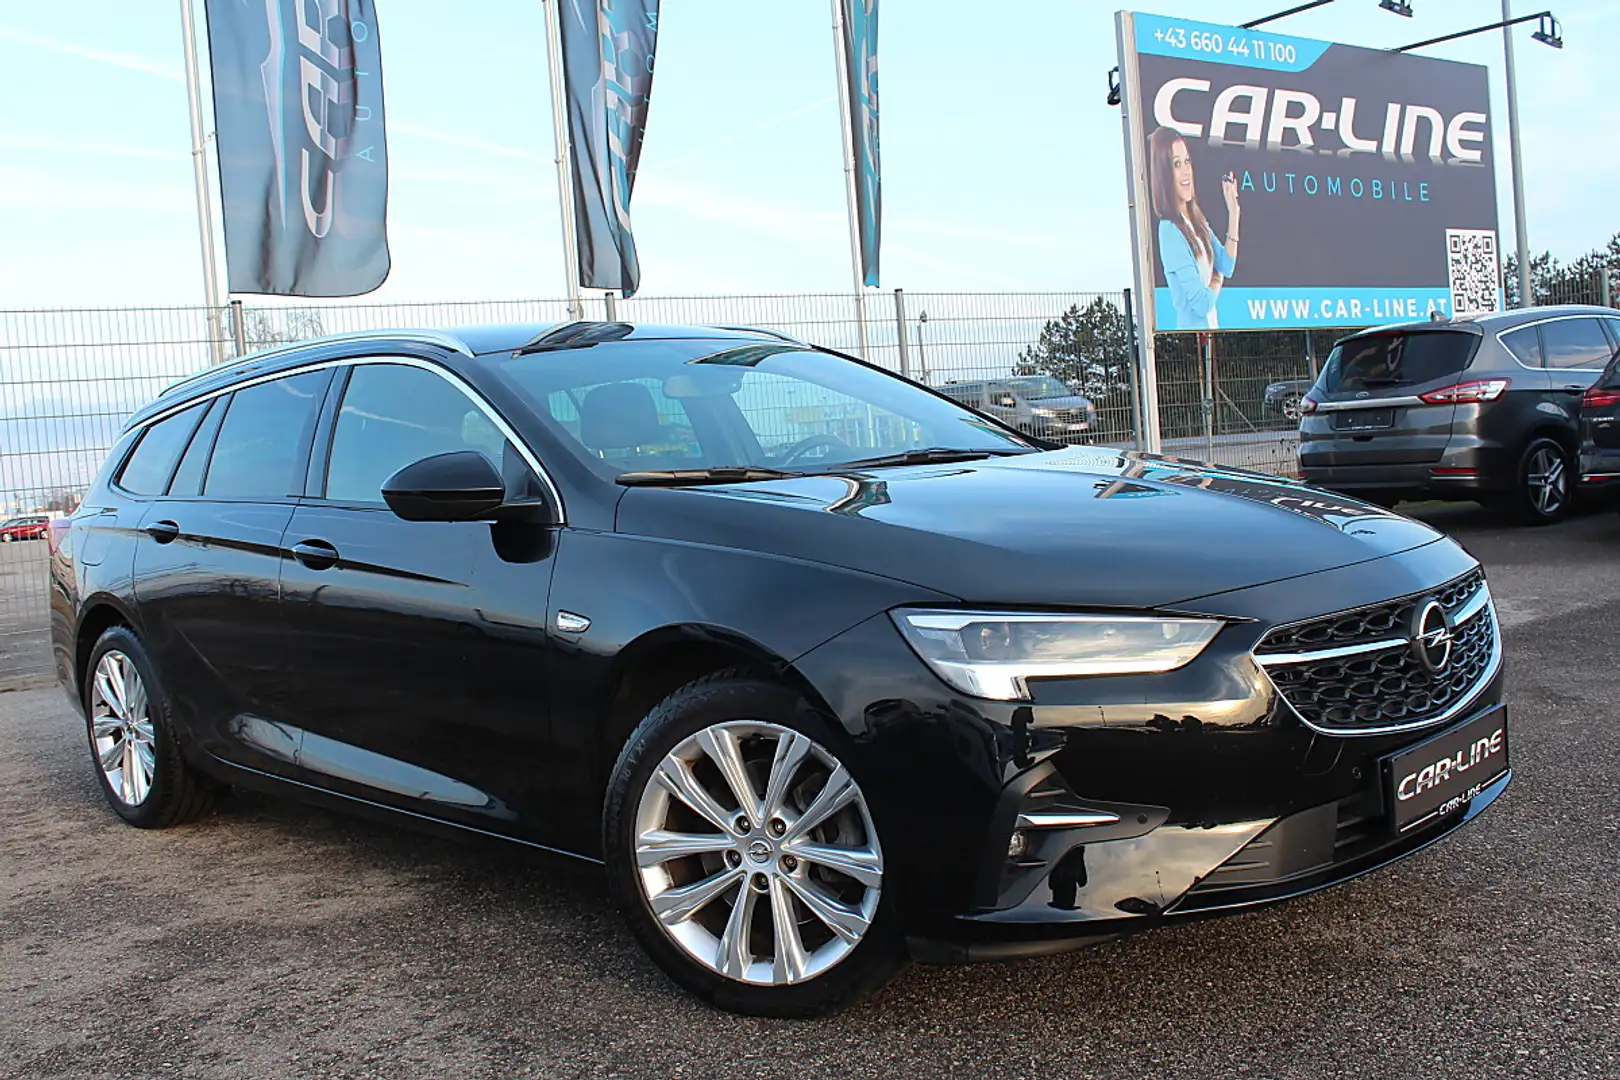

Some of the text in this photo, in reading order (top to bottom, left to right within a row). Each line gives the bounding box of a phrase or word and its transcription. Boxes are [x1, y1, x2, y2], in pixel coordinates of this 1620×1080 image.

[1154, 27, 1296, 64] +43 660 44 11 100
[1241, 170, 1430, 201] AUTOMOBILE
[1247, 298, 1448, 320] WWW.CAR-LINE.AT
